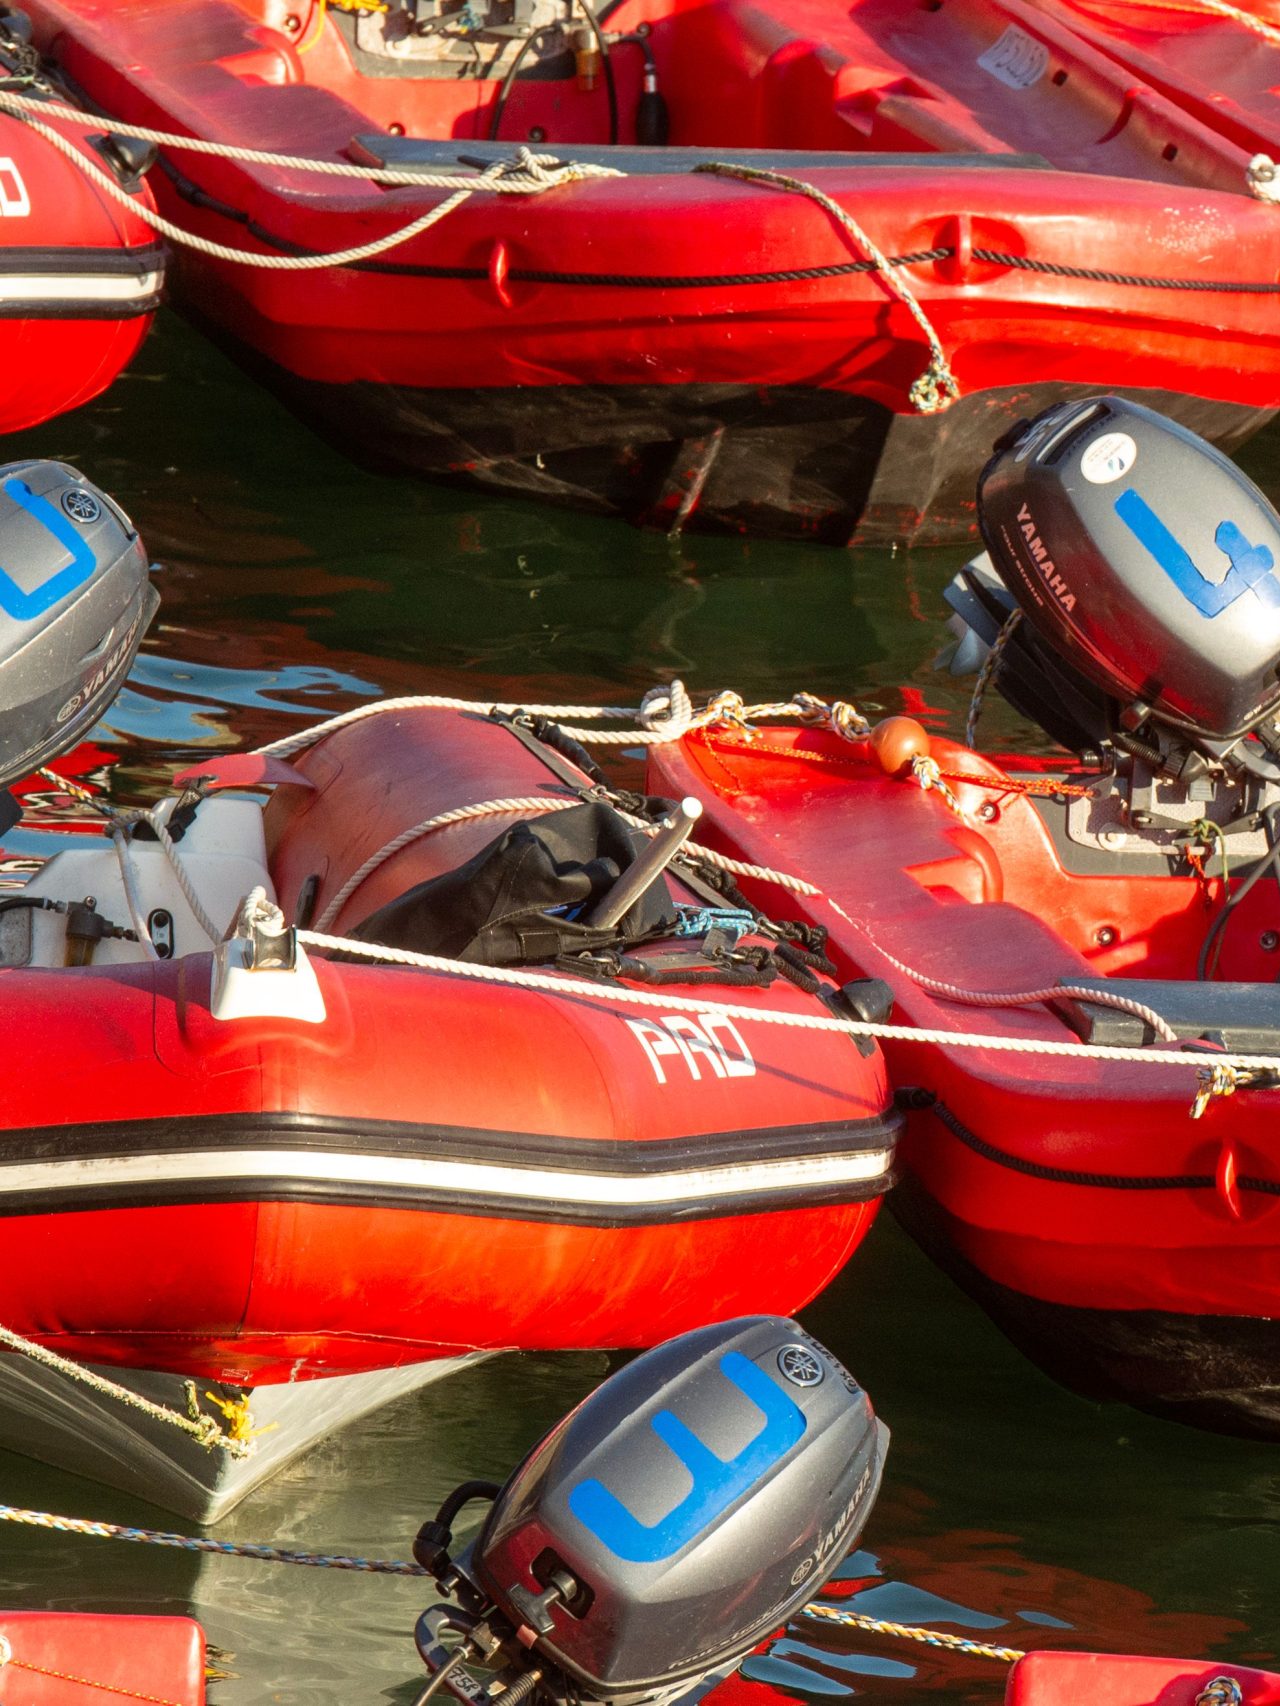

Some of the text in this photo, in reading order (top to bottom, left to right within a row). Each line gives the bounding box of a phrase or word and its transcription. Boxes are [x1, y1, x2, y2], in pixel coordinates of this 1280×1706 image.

[1017, 502, 1077, 612] YAMAHA
[625, 1013, 757, 1084] PRO
[814, 1464, 870, 1562] YAMAHA
